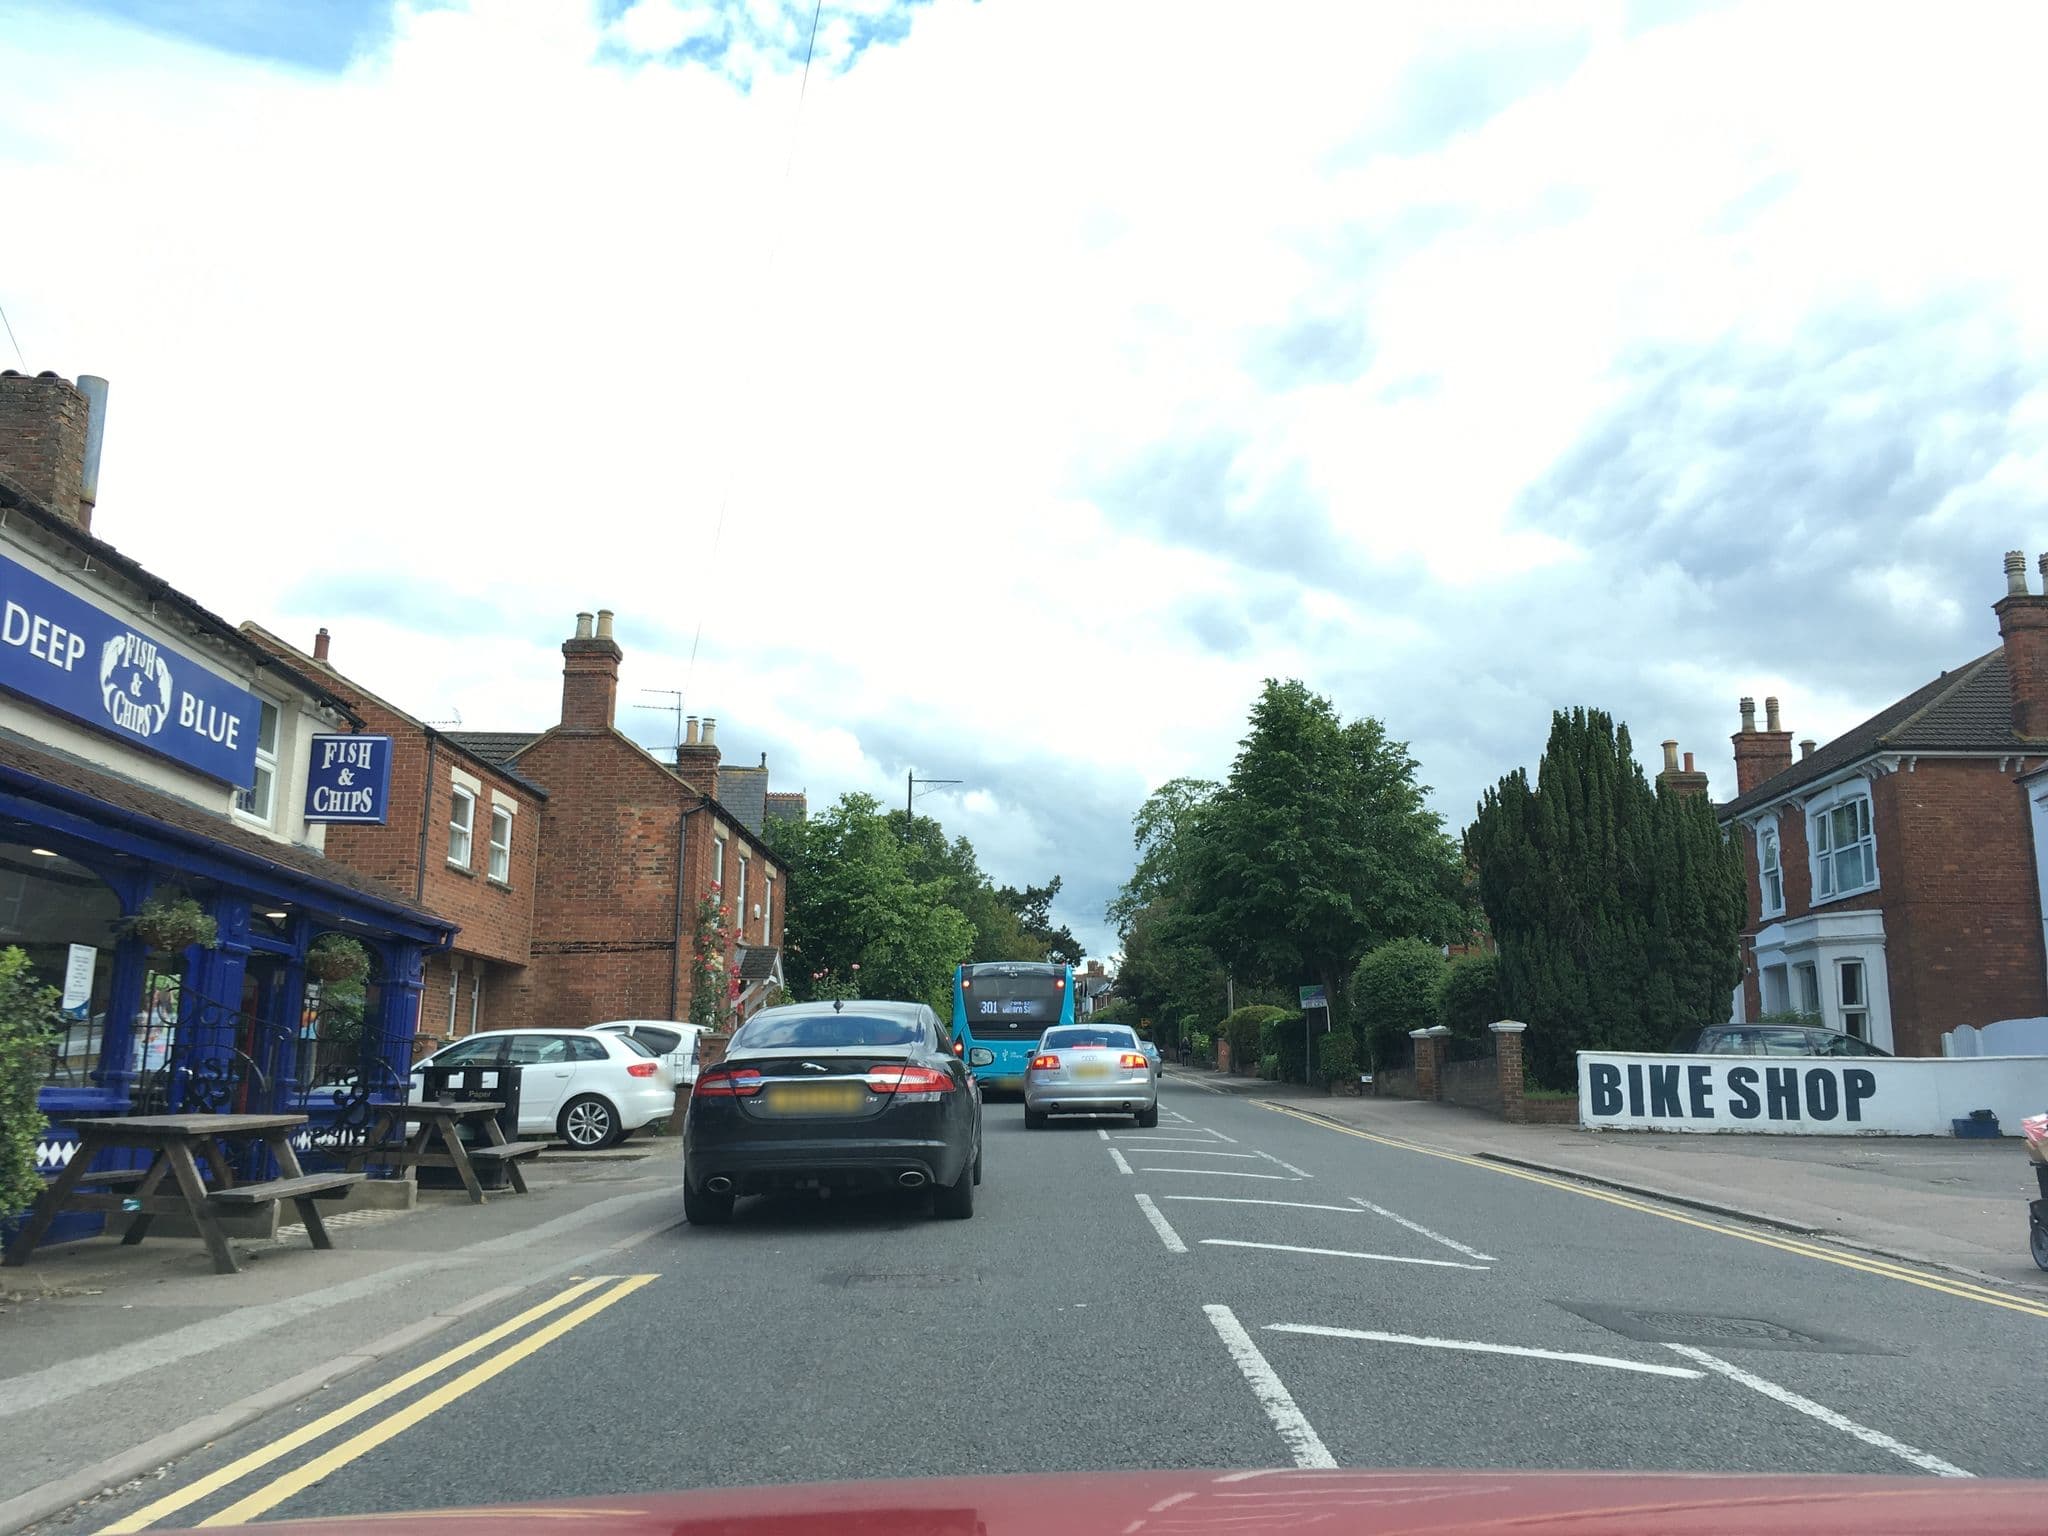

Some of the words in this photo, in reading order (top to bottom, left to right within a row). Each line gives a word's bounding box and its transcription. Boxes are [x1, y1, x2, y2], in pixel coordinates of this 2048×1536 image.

[121, 631, 157, 681] FISH
[1, 600, 86, 672] DEEP
[179, 691, 241, 751] BLUE
[130, 672, 143, 697] &
[112, 690, 153, 737] CHIPS
[321, 742, 374, 770] FISH
[338, 767, 356, 786] &
[313, 786, 374, 813] CHIPS
[980, 1000, 998, 1014] 301
[1588, 1063, 1716, 1119] BIKE
[1726, 1066, 1877, 1122] SHOP
